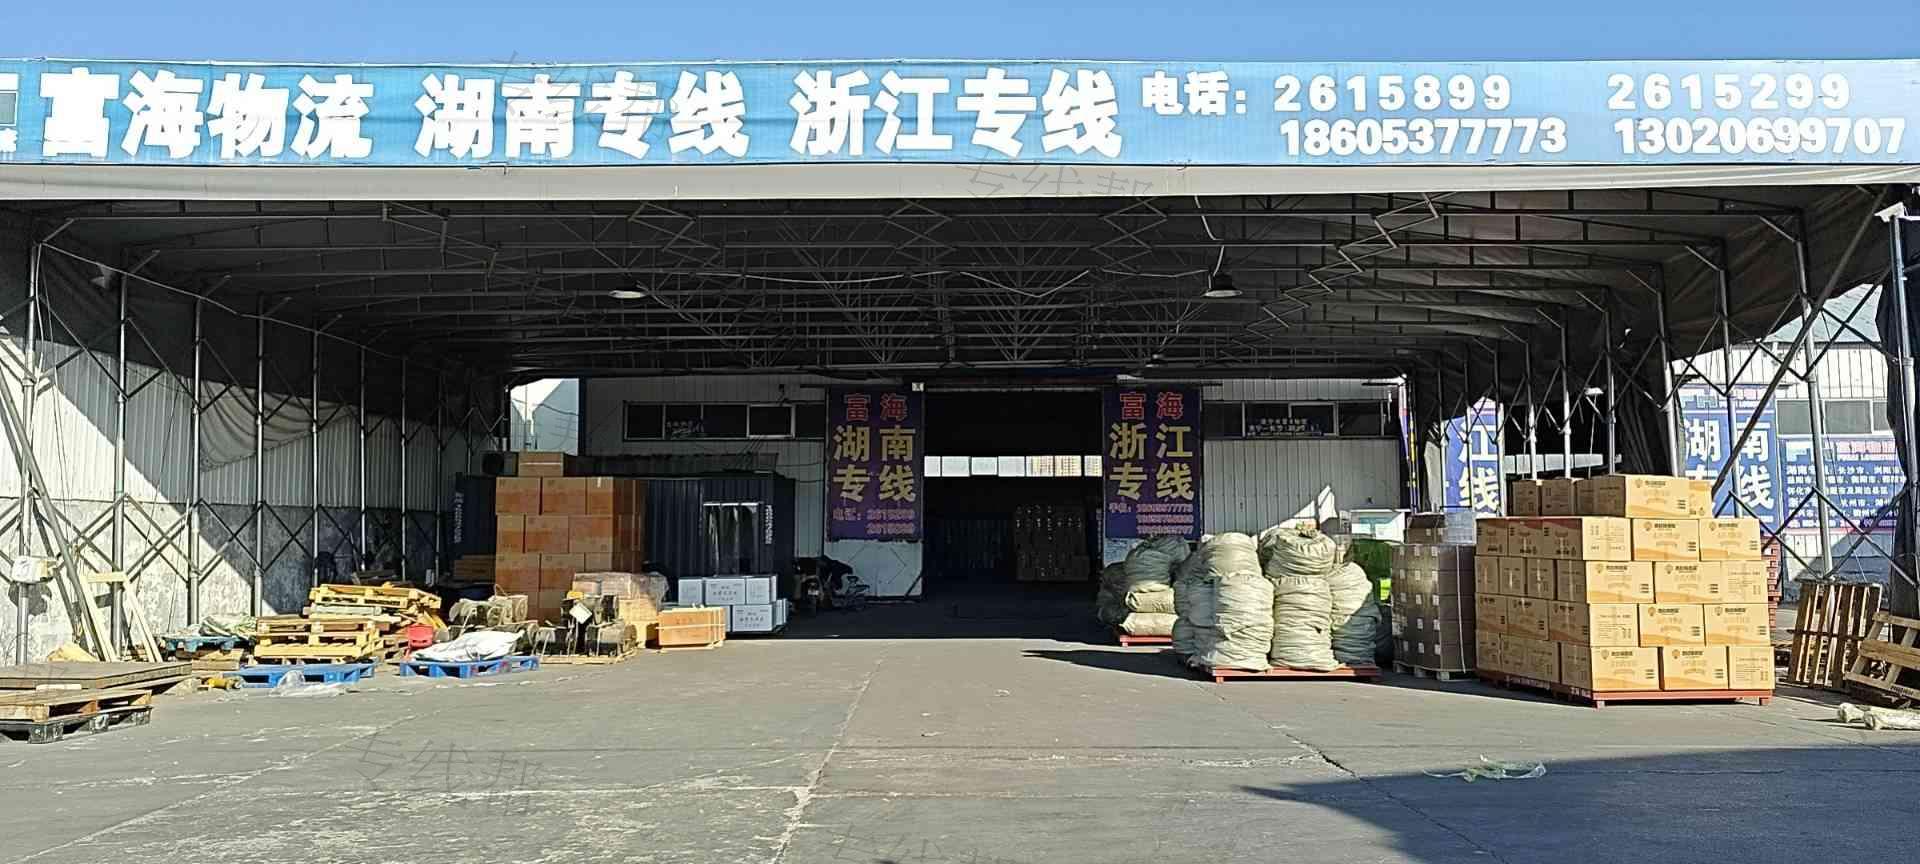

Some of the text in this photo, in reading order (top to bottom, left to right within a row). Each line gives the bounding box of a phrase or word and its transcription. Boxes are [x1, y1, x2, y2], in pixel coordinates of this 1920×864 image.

[40, 67, 1851, 159] 富海物流 湖南专线 浙江专线 电话： 2615899 2615299
[1280, 116, 1905, 156] 18605377773 13020699707
[846, 393, 909, 421] 富海
[1119, 393, 1184, 421] 富海
[833, 425, 916, 462] 湖南
[1109, 424, 1193, 461] 浙江
[1684, 417, 1771, 463] 湖南
[833, 465, 917, 503] 专线
[1109, 464, 1195, 503] 专线
